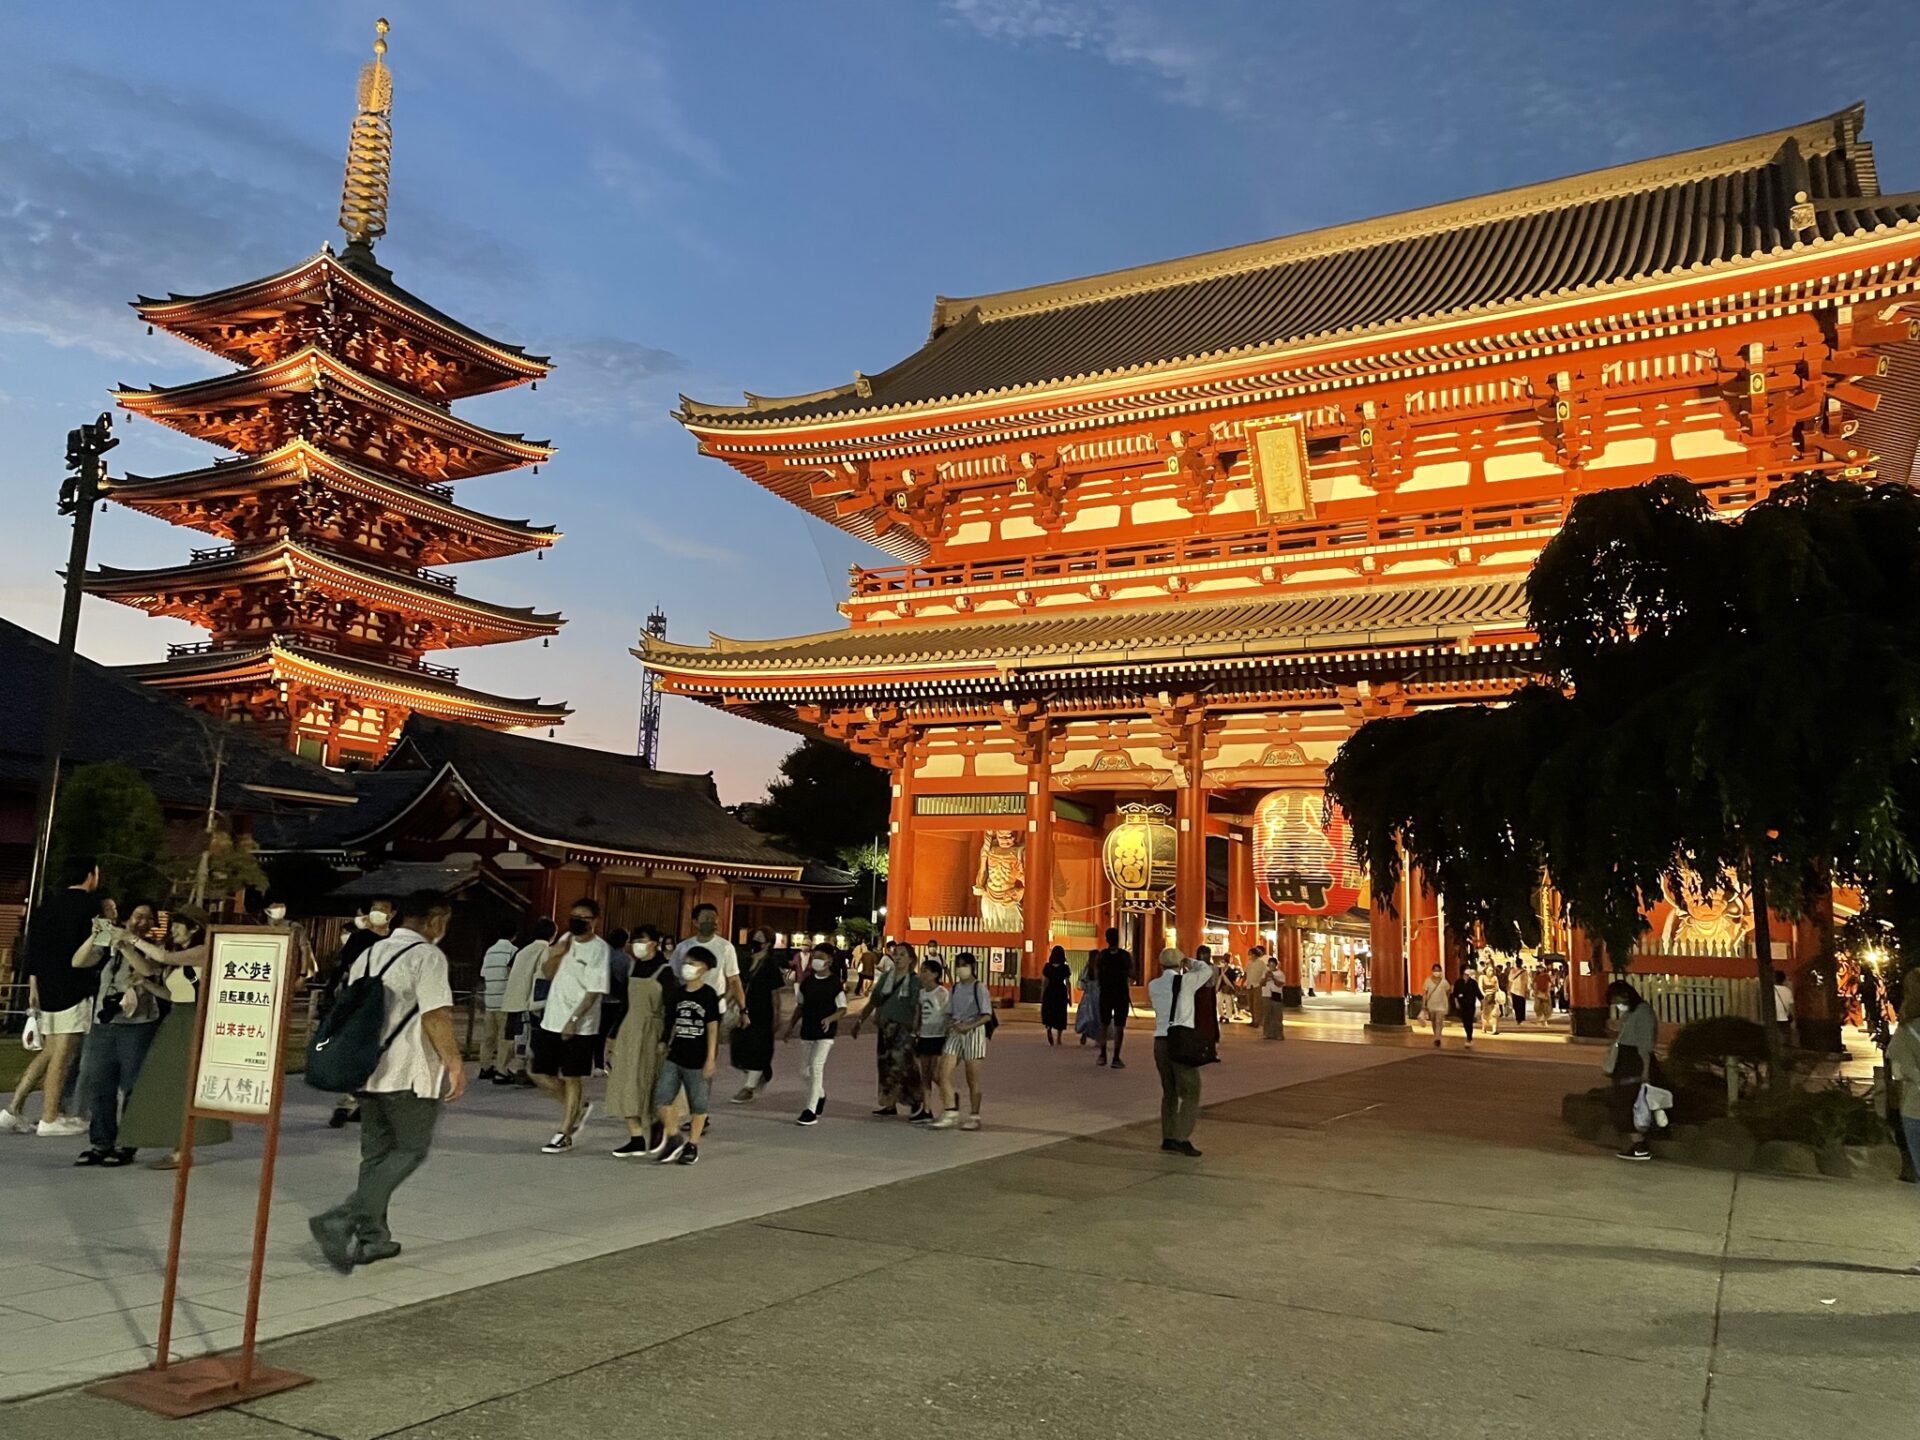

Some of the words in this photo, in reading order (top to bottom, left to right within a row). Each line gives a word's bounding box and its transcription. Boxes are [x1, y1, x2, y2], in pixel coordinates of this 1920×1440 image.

[224, 960, 272, 980] 食べ歩き
[219, 990, 270, 1005] 自転車乗入れ
[215, 1022, 265, 1038] 出来ません
[200, 1075, 270, 1105] 進入禁止
